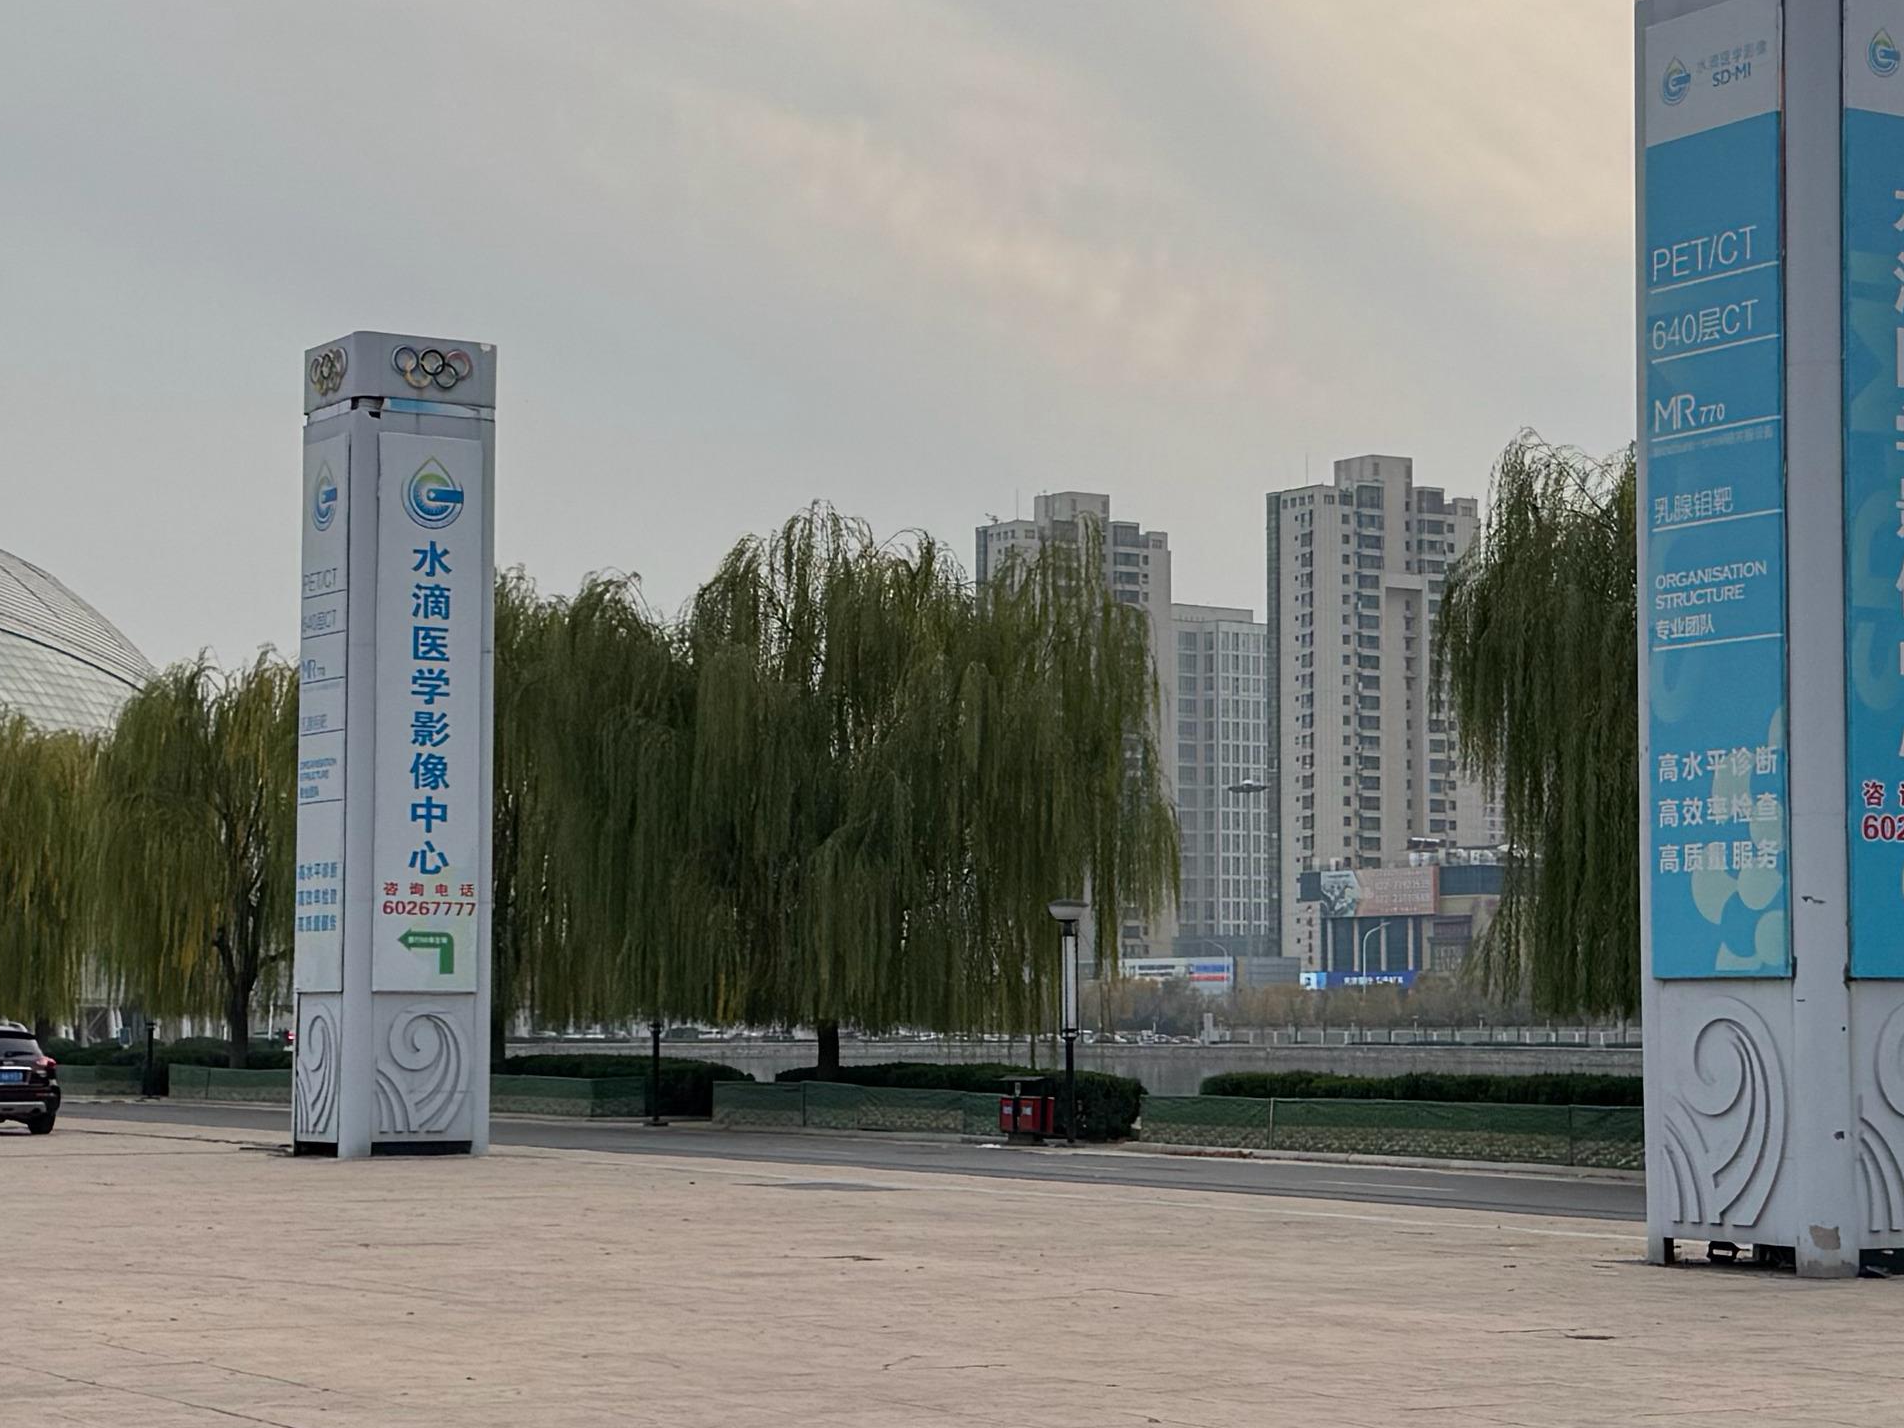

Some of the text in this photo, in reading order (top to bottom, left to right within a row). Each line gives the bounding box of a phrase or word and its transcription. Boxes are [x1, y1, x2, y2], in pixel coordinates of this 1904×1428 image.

[1653, 225, 1758, 282] PET/CT
[1652, 299, 1759, 351] 640层CT
[1655, 393, 1725, 433] MR 770
[1655, 560, 1768, 590] ORGANISATION
[1655, 584, 1746, 611] STRUCTURE
[1655, 615, 1716, 641] 专业团队
[408, 540, 453, 875] 水滴医学影像中心
[1658, 746, 1779, 783] 高水平诊断
[1658, 793, 1780, 829] 高效率检查
[1658, 843, 1780, 874] 高质量服务
[383, 882, 475, 898] 咨询电话
[382, 900, 477, 917] 60267777
